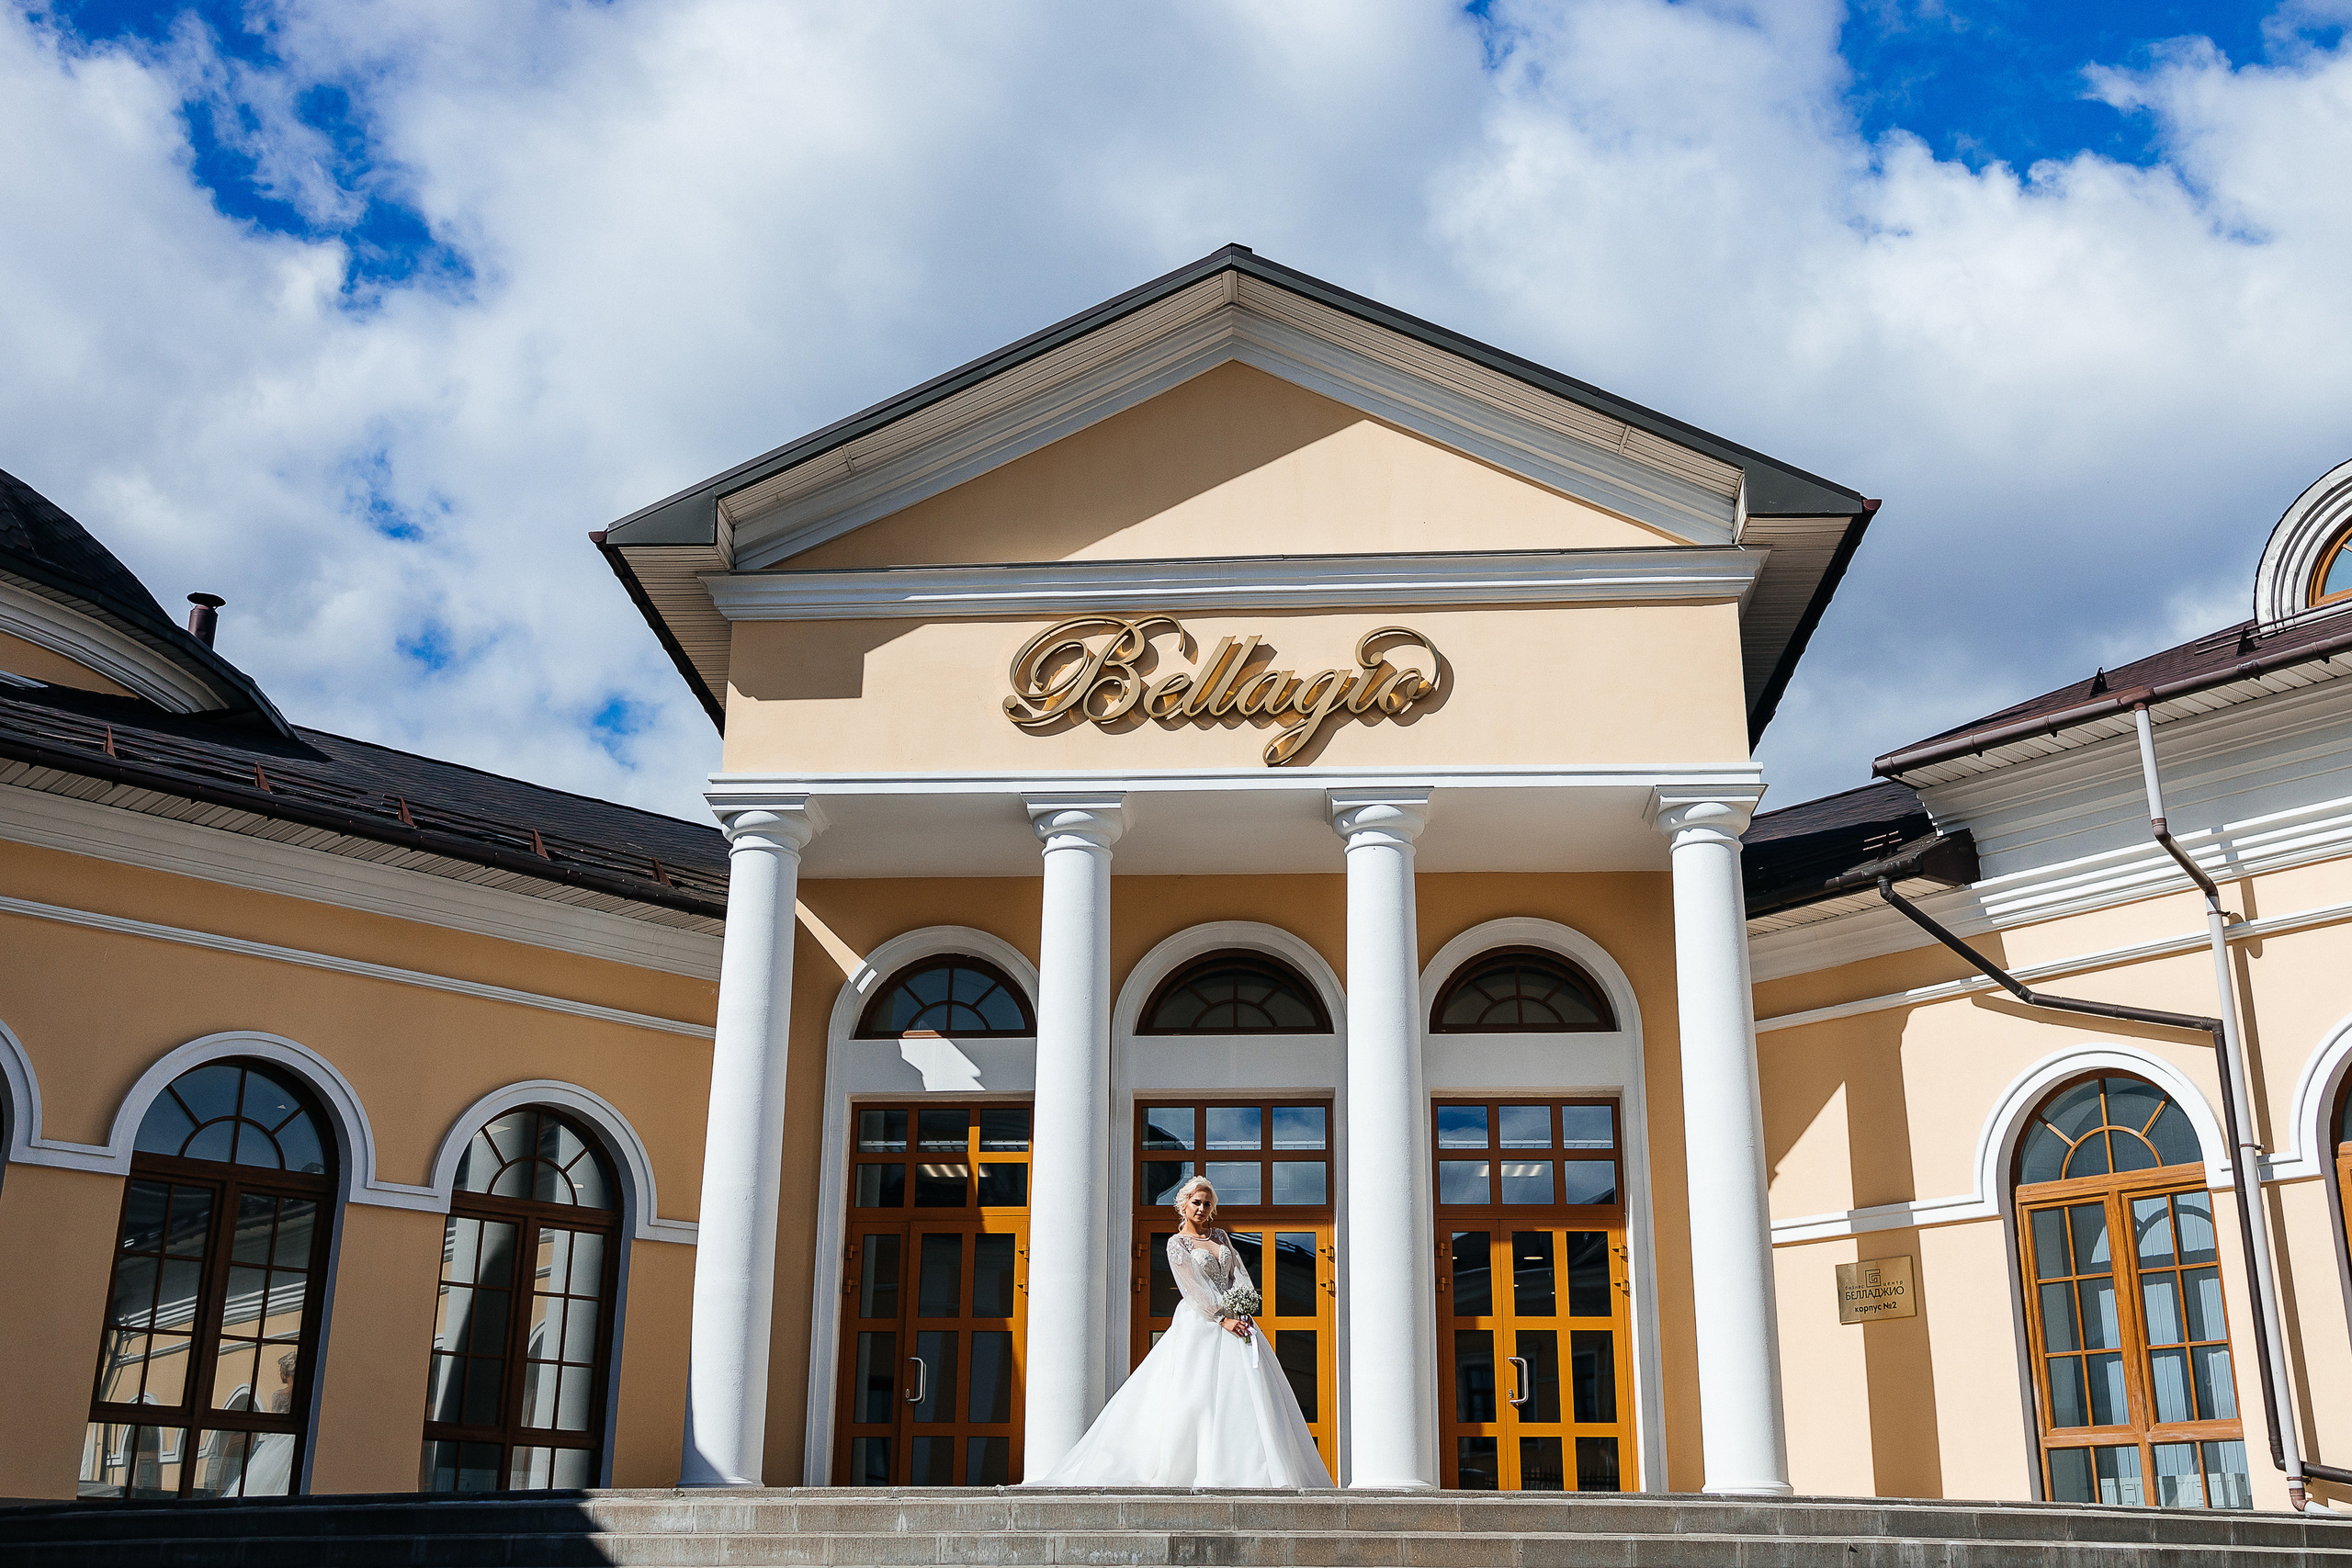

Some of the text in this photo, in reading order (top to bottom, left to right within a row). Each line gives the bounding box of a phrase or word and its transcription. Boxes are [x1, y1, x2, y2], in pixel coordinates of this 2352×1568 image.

[1002, 615, 1442, 768] Bellagio
[1845, 1286, 1905, 1301] БЕЛЛАДЖИО
[1854, 1301, 1897, 1314] корпус №2
